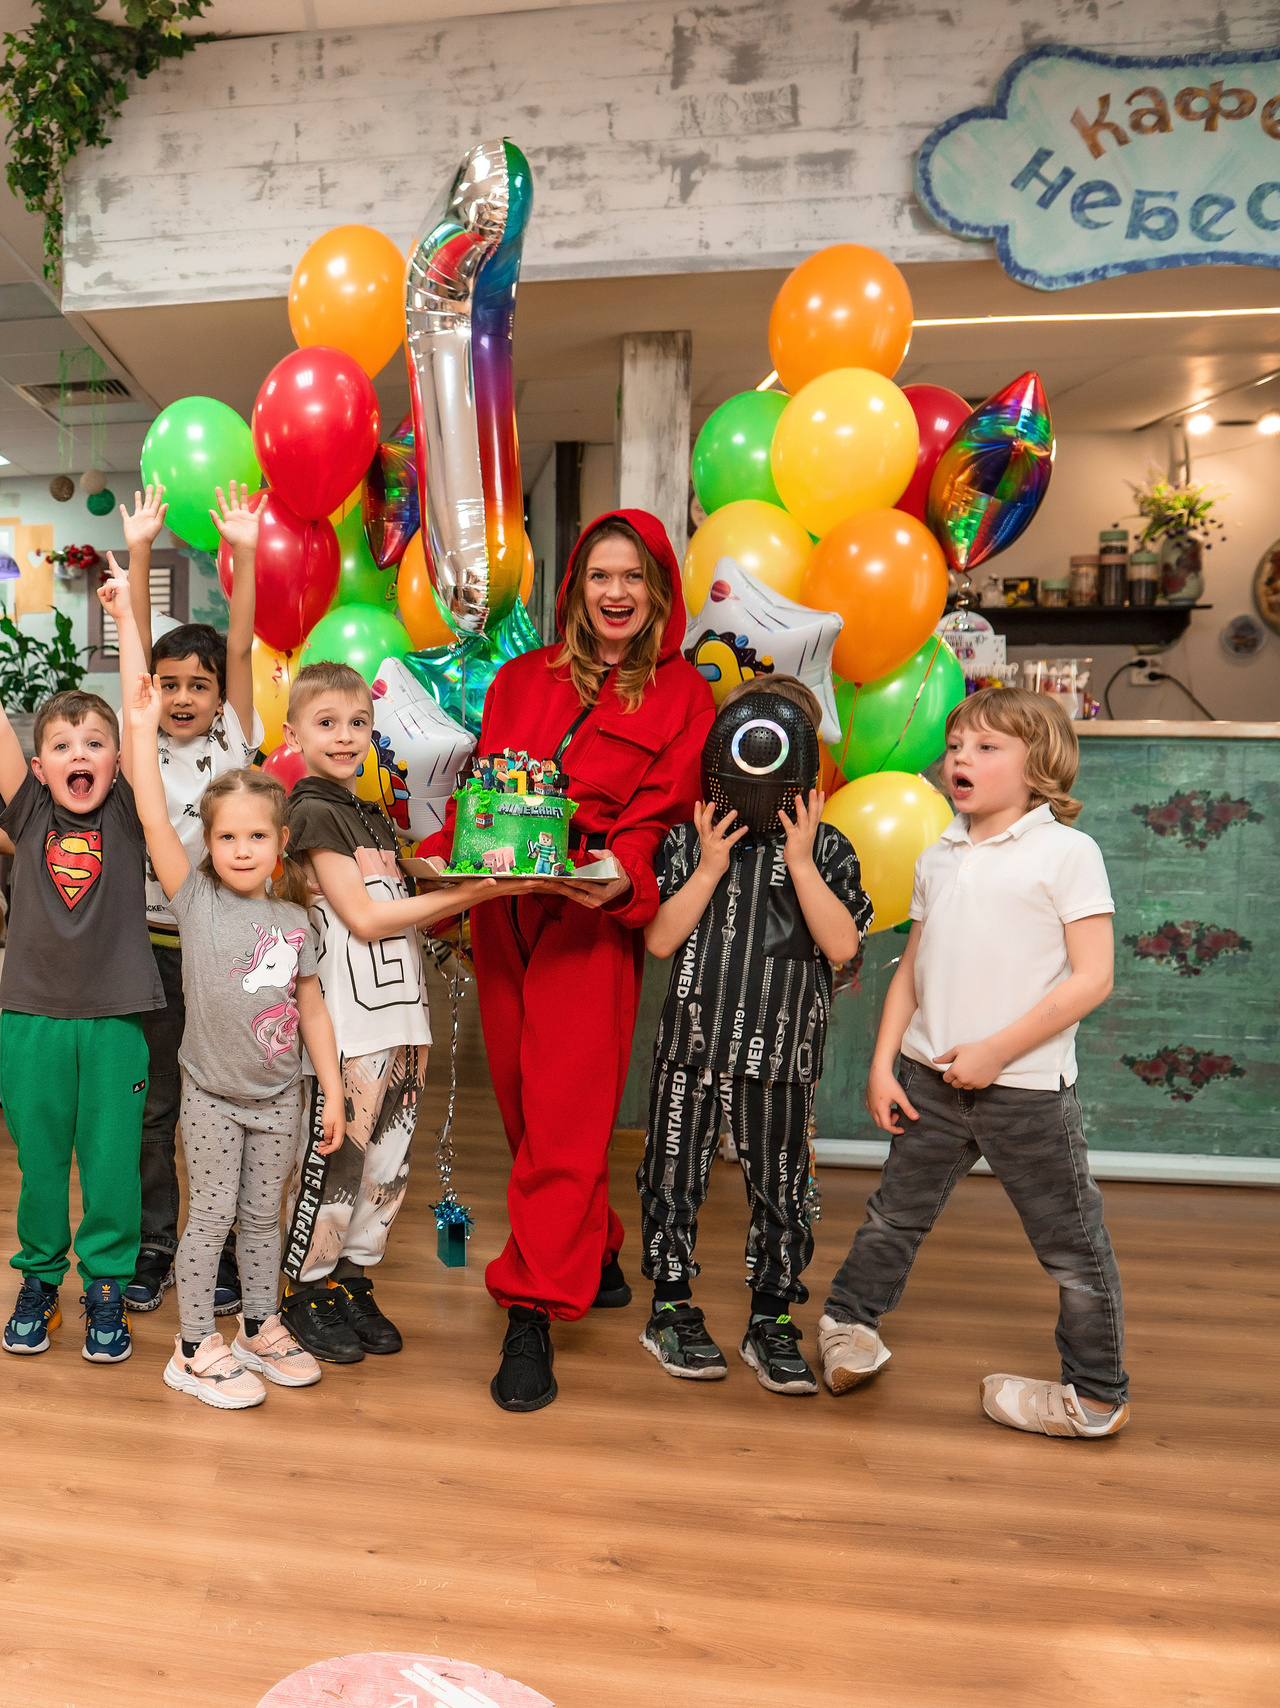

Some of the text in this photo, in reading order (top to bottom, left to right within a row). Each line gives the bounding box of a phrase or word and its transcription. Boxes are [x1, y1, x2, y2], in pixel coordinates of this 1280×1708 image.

[498, 802, 565, 819] MINECRAFT
[146, 904, 166, 912] CKEY
[731, 1009, 746, 1040] GLVR
[744, 1036, 765, 1079] MED
[665, 1070, 687, 1156] UNTAMED
[778, 1151, 788, 1183] GLVR
[292, 1190, 321, 1246] SPORT
[283, 1247, 307, 1281] LVR
